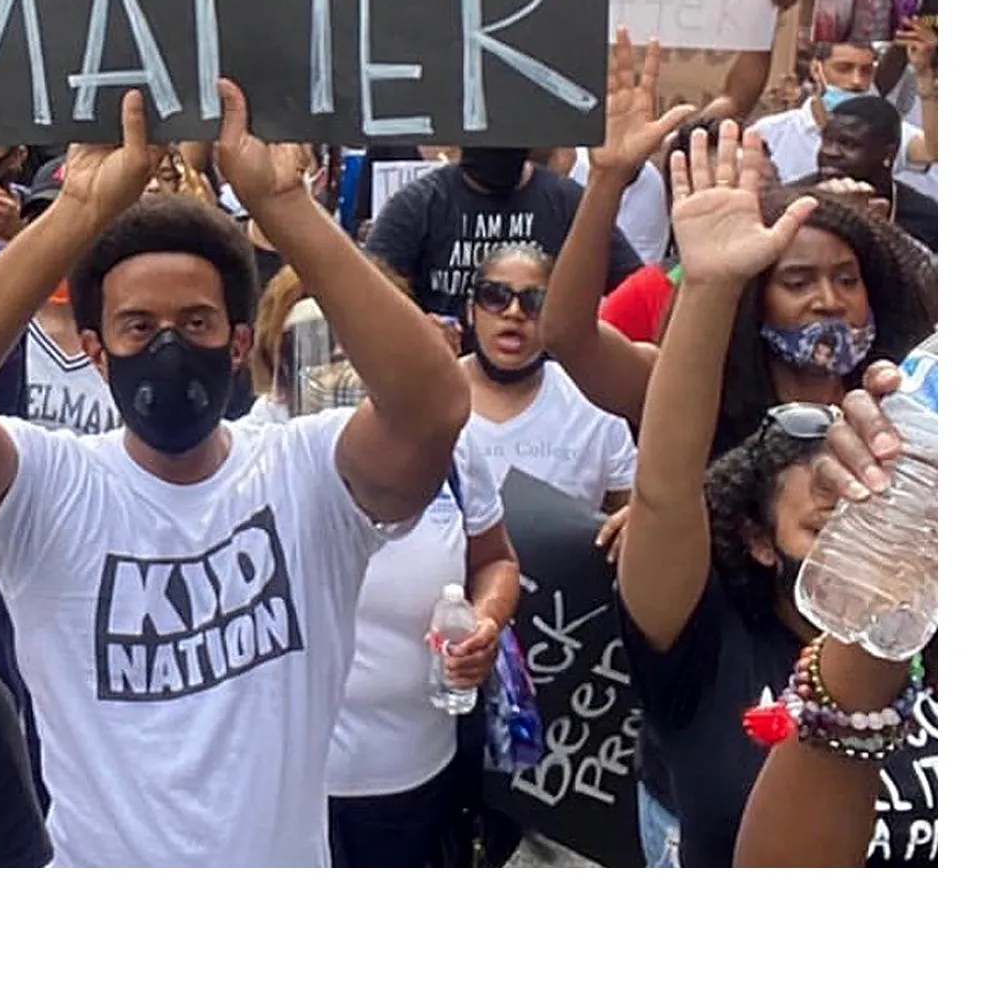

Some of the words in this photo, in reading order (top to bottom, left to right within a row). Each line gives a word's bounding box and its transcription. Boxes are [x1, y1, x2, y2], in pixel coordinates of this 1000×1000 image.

[462, 213, 467, 237] I
[475, 213, 502, 238] AM
[508, 212, 534, 237] MY
[109, 527, 276, 636] KID
[107, 597, 289, 694] NATION
